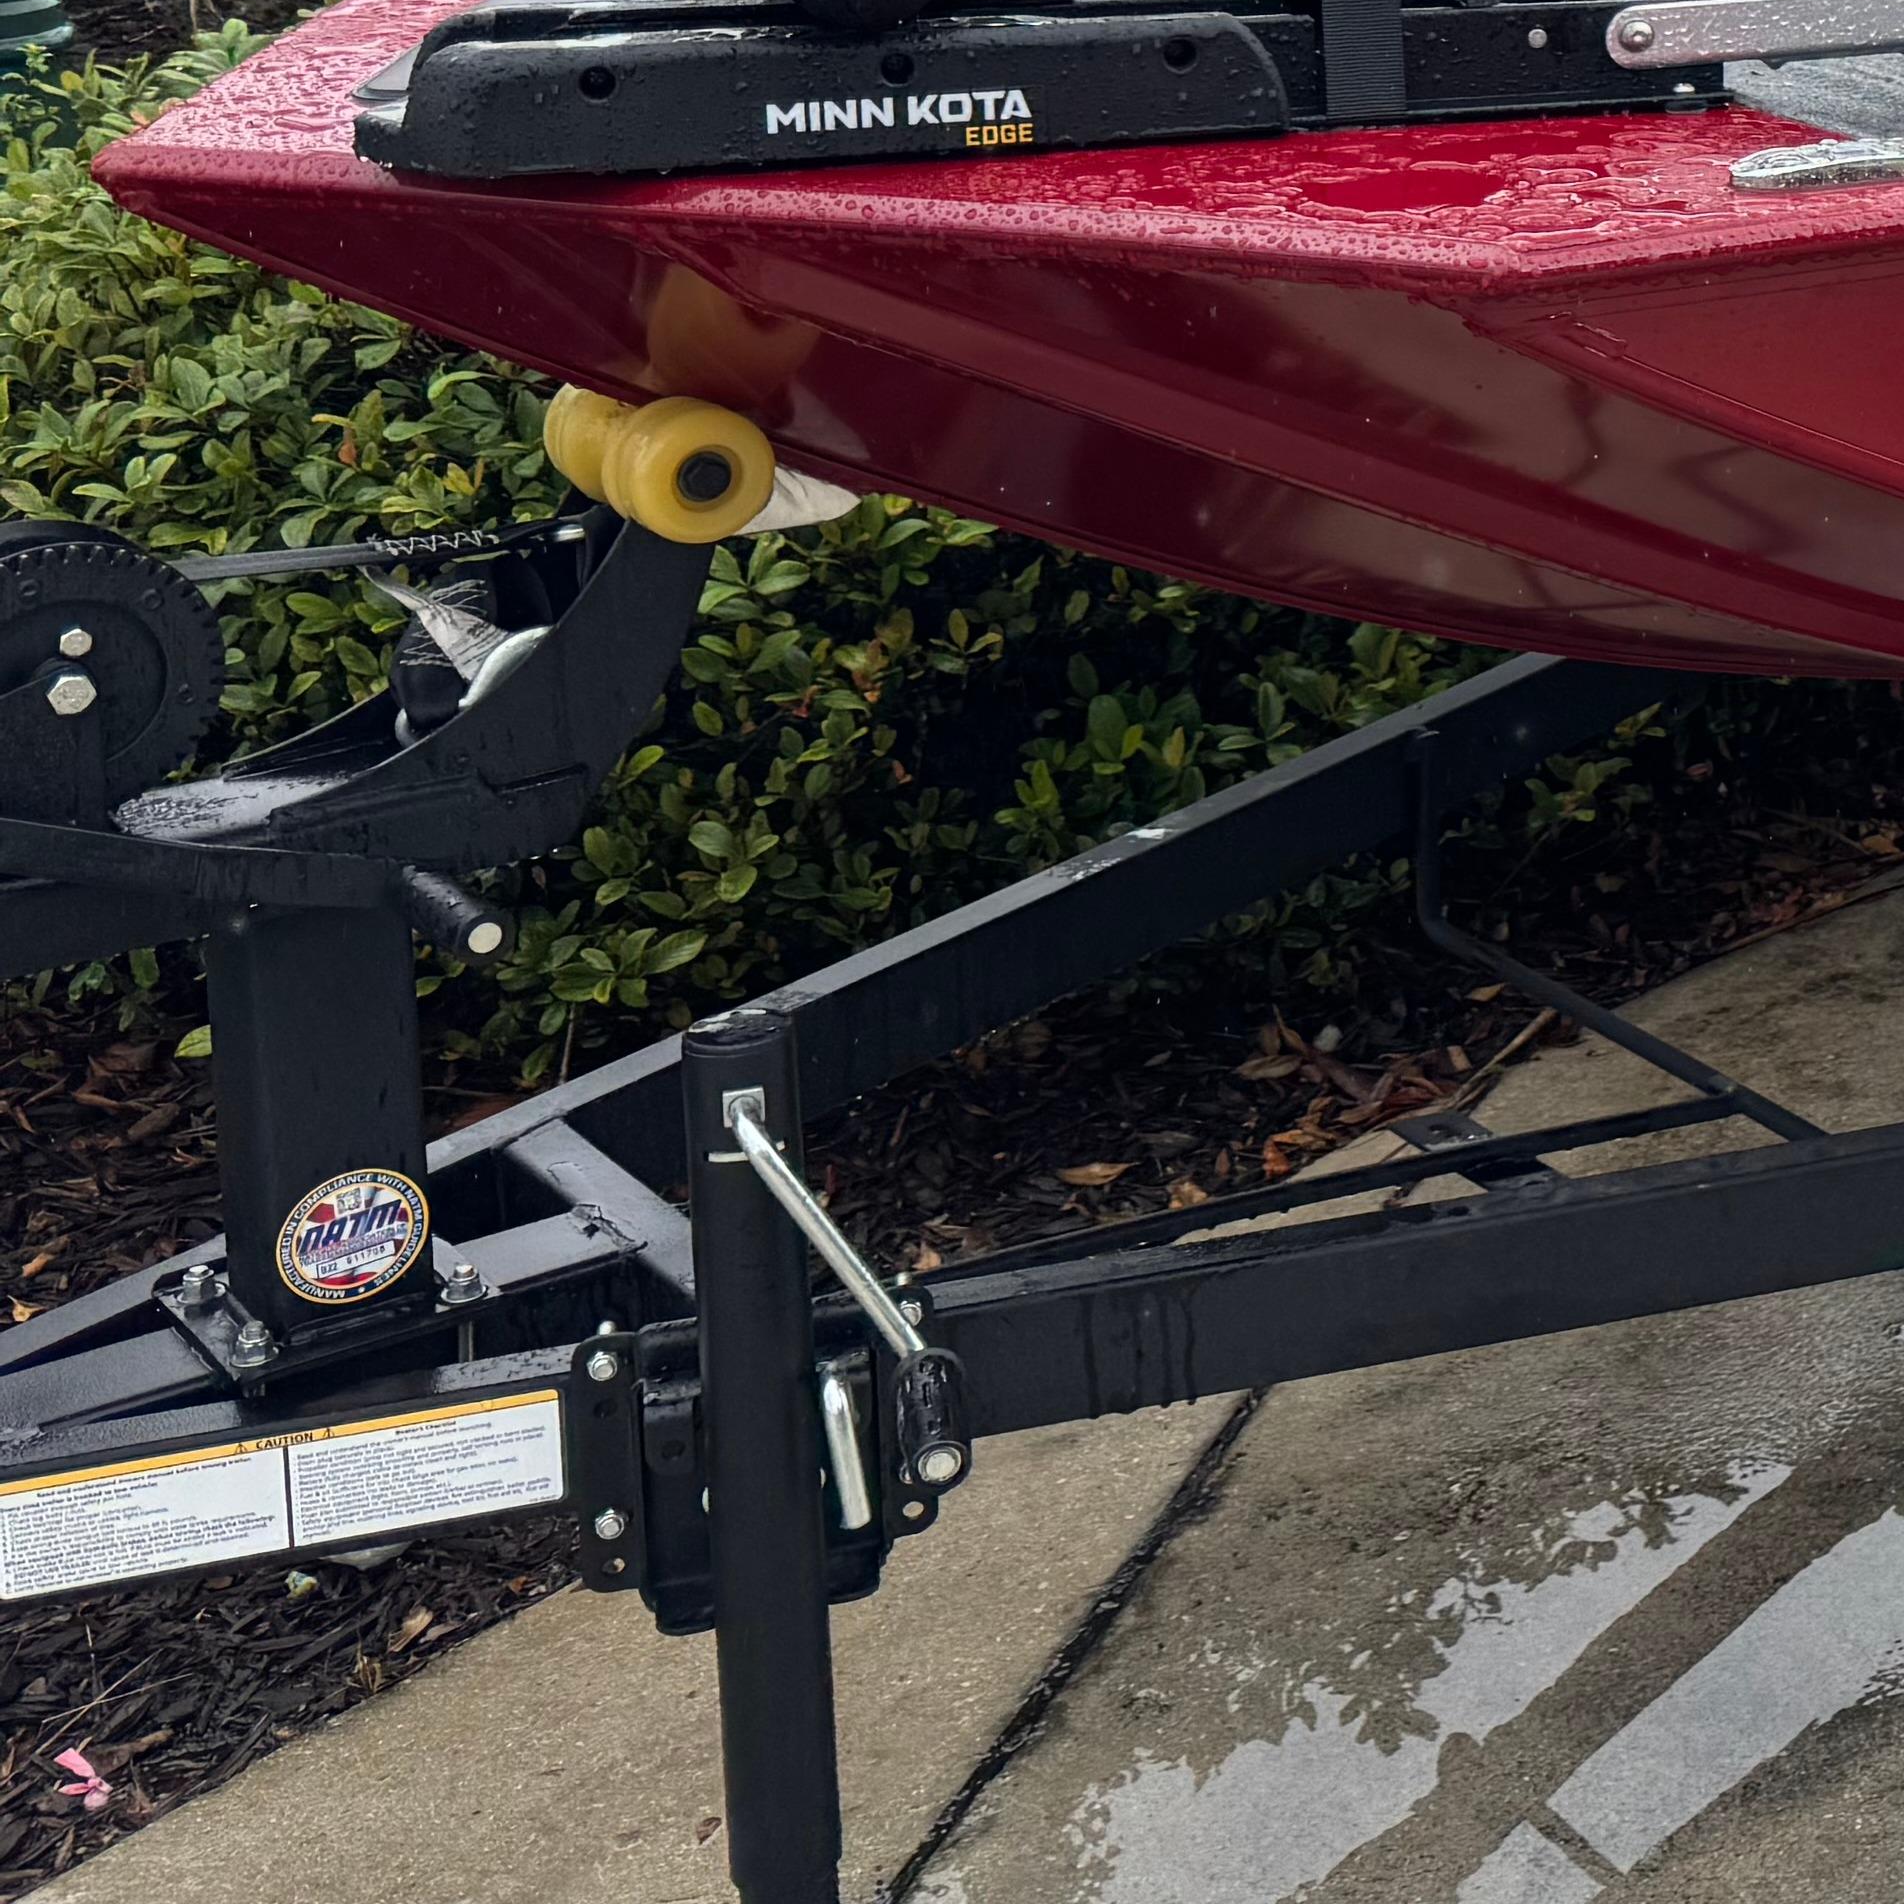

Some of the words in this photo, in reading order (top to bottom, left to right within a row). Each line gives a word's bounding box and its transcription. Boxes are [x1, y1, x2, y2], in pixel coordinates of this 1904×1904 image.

[766, 97, 895, 134] MINN
[907, 89, 1032, 125] KOTA
[965, 123, 1033, 146] EDGE
[295, 1173, 374, 1219] COMPLIANCE
[377, 1173, 408, 1192] WITH
[405, 1189, 423, 1221] NATM
[287, 1222, 298, 1233] IN
[281, 1237, 346, 1299] MANUFACTURED
[256, 1432, 313, 1449] CAUTION
